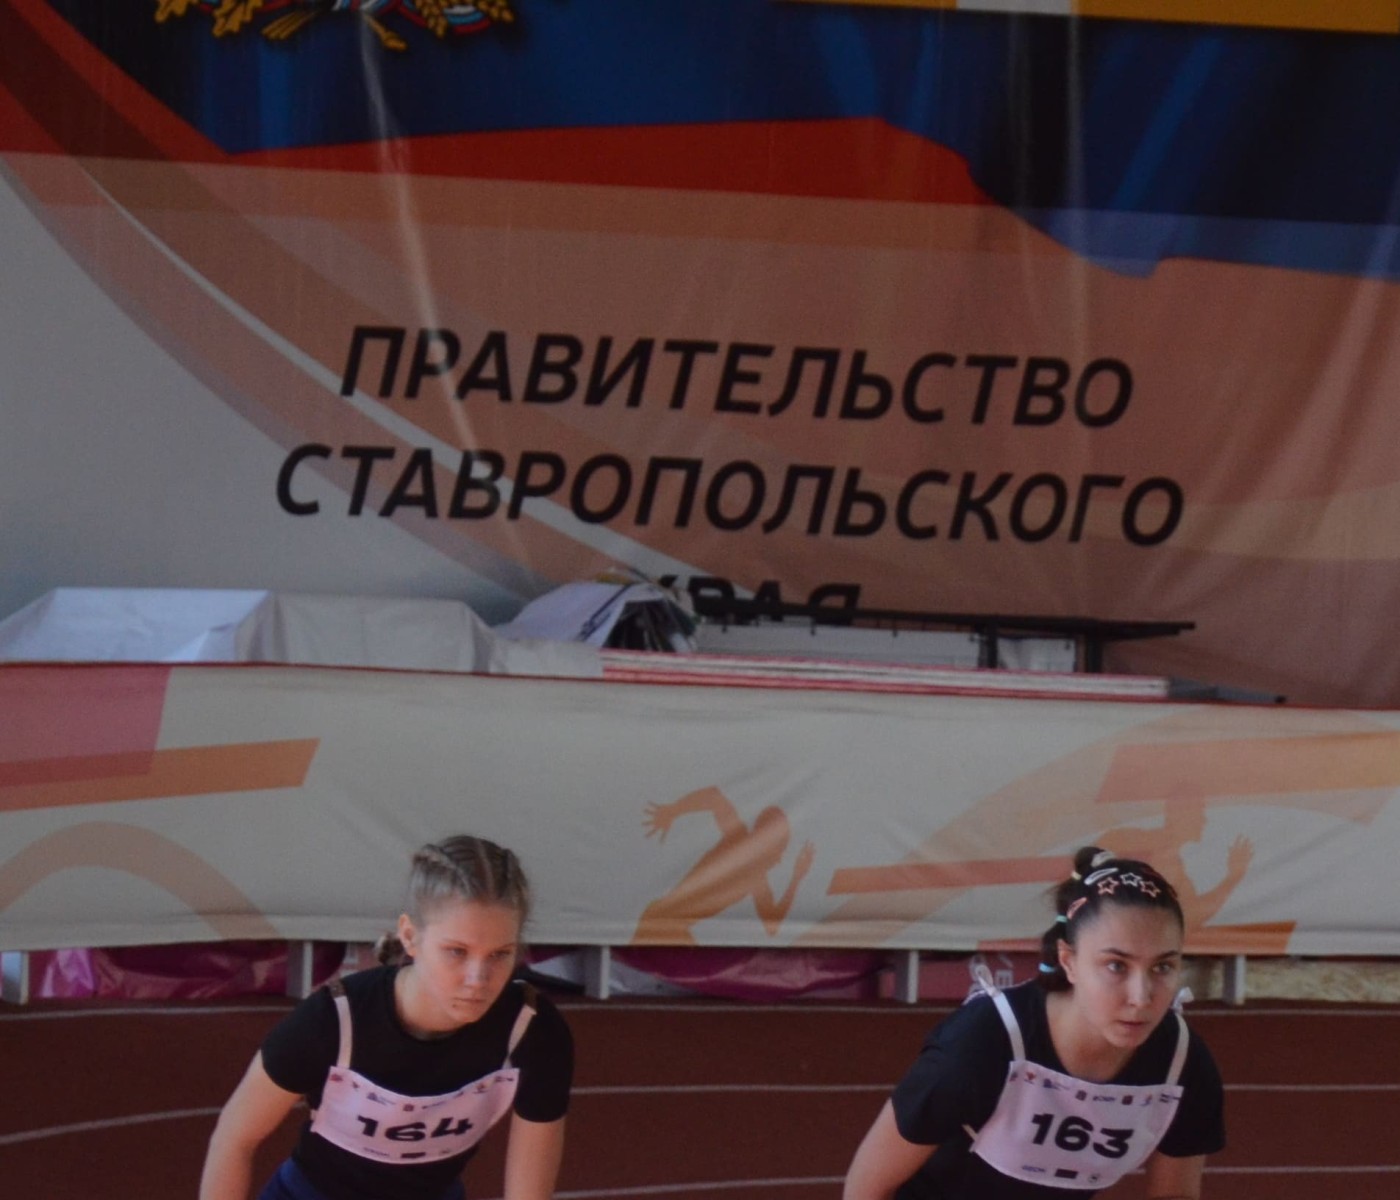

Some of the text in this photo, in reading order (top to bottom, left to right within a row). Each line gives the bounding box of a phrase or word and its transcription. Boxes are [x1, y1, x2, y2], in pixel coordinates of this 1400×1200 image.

[341, 326, 1133, 428] ПРАВИТЕЛЬСТВО
[276, 443, 1184, 546] СТАВРОПОЛЬСКОГО
[660, 574, 861, 626] РАЯ
[357, 1114, 473, 1142] 164
[1031, 1113, 1134, 1159] 163
